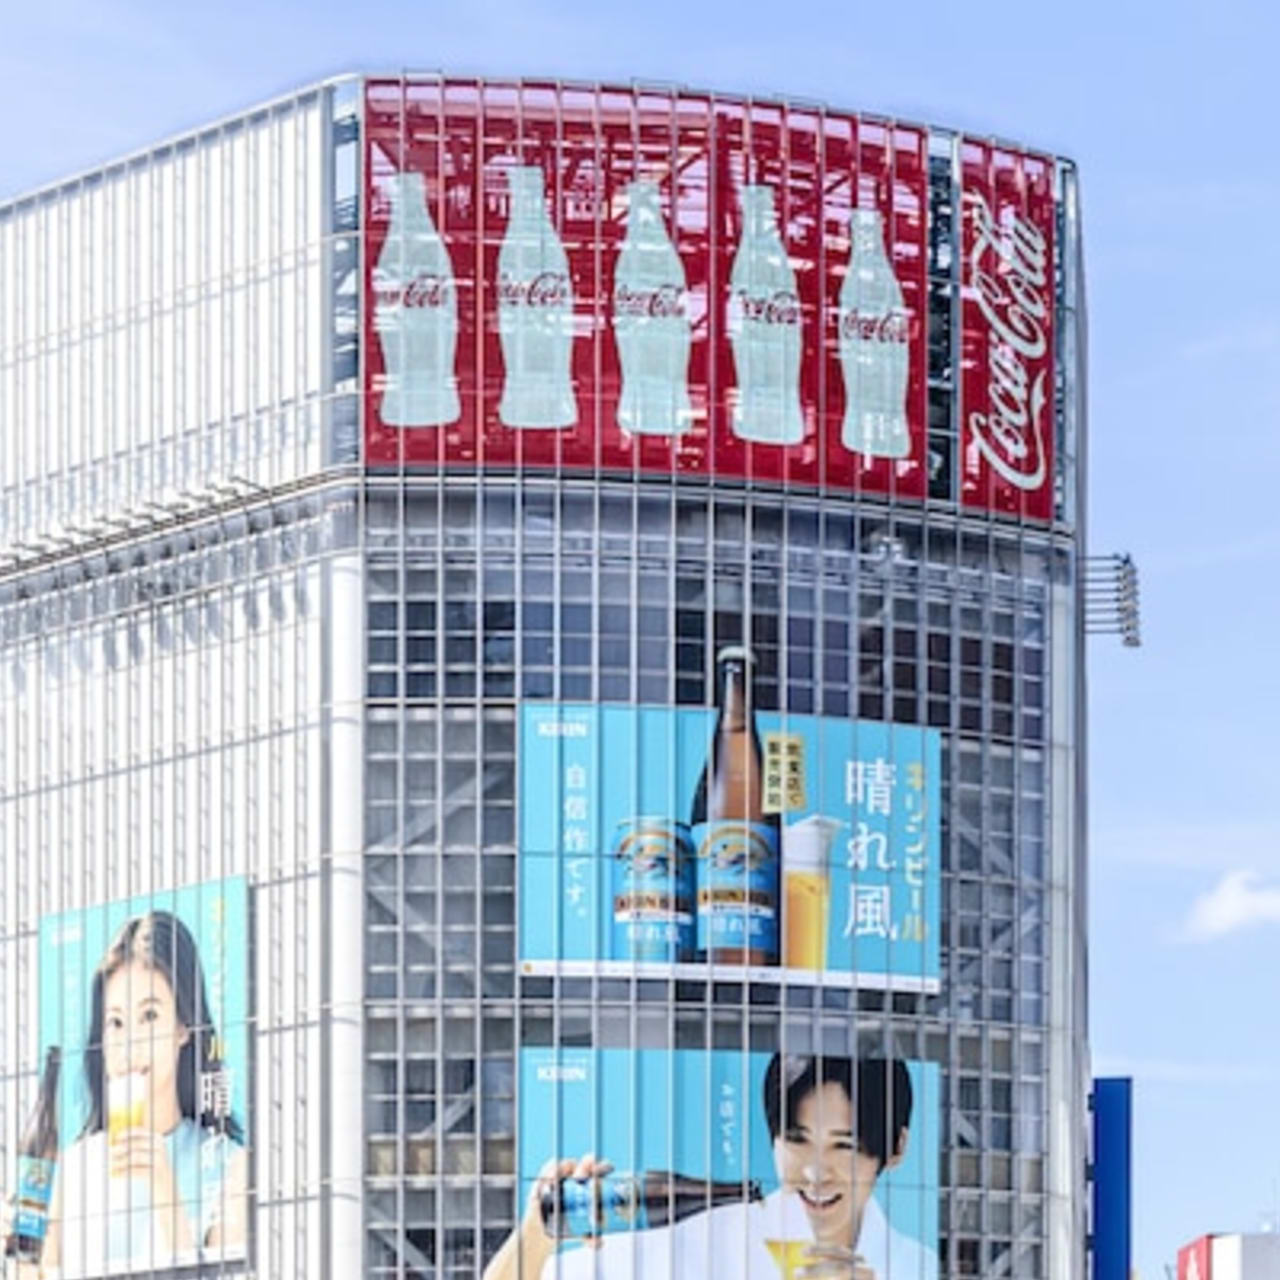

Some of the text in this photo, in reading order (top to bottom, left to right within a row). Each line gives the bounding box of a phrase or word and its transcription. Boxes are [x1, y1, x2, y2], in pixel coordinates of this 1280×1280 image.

[969, 188, 1048, 491] Coca-Cola
[843, 757, 898, 942] 晴れ風
